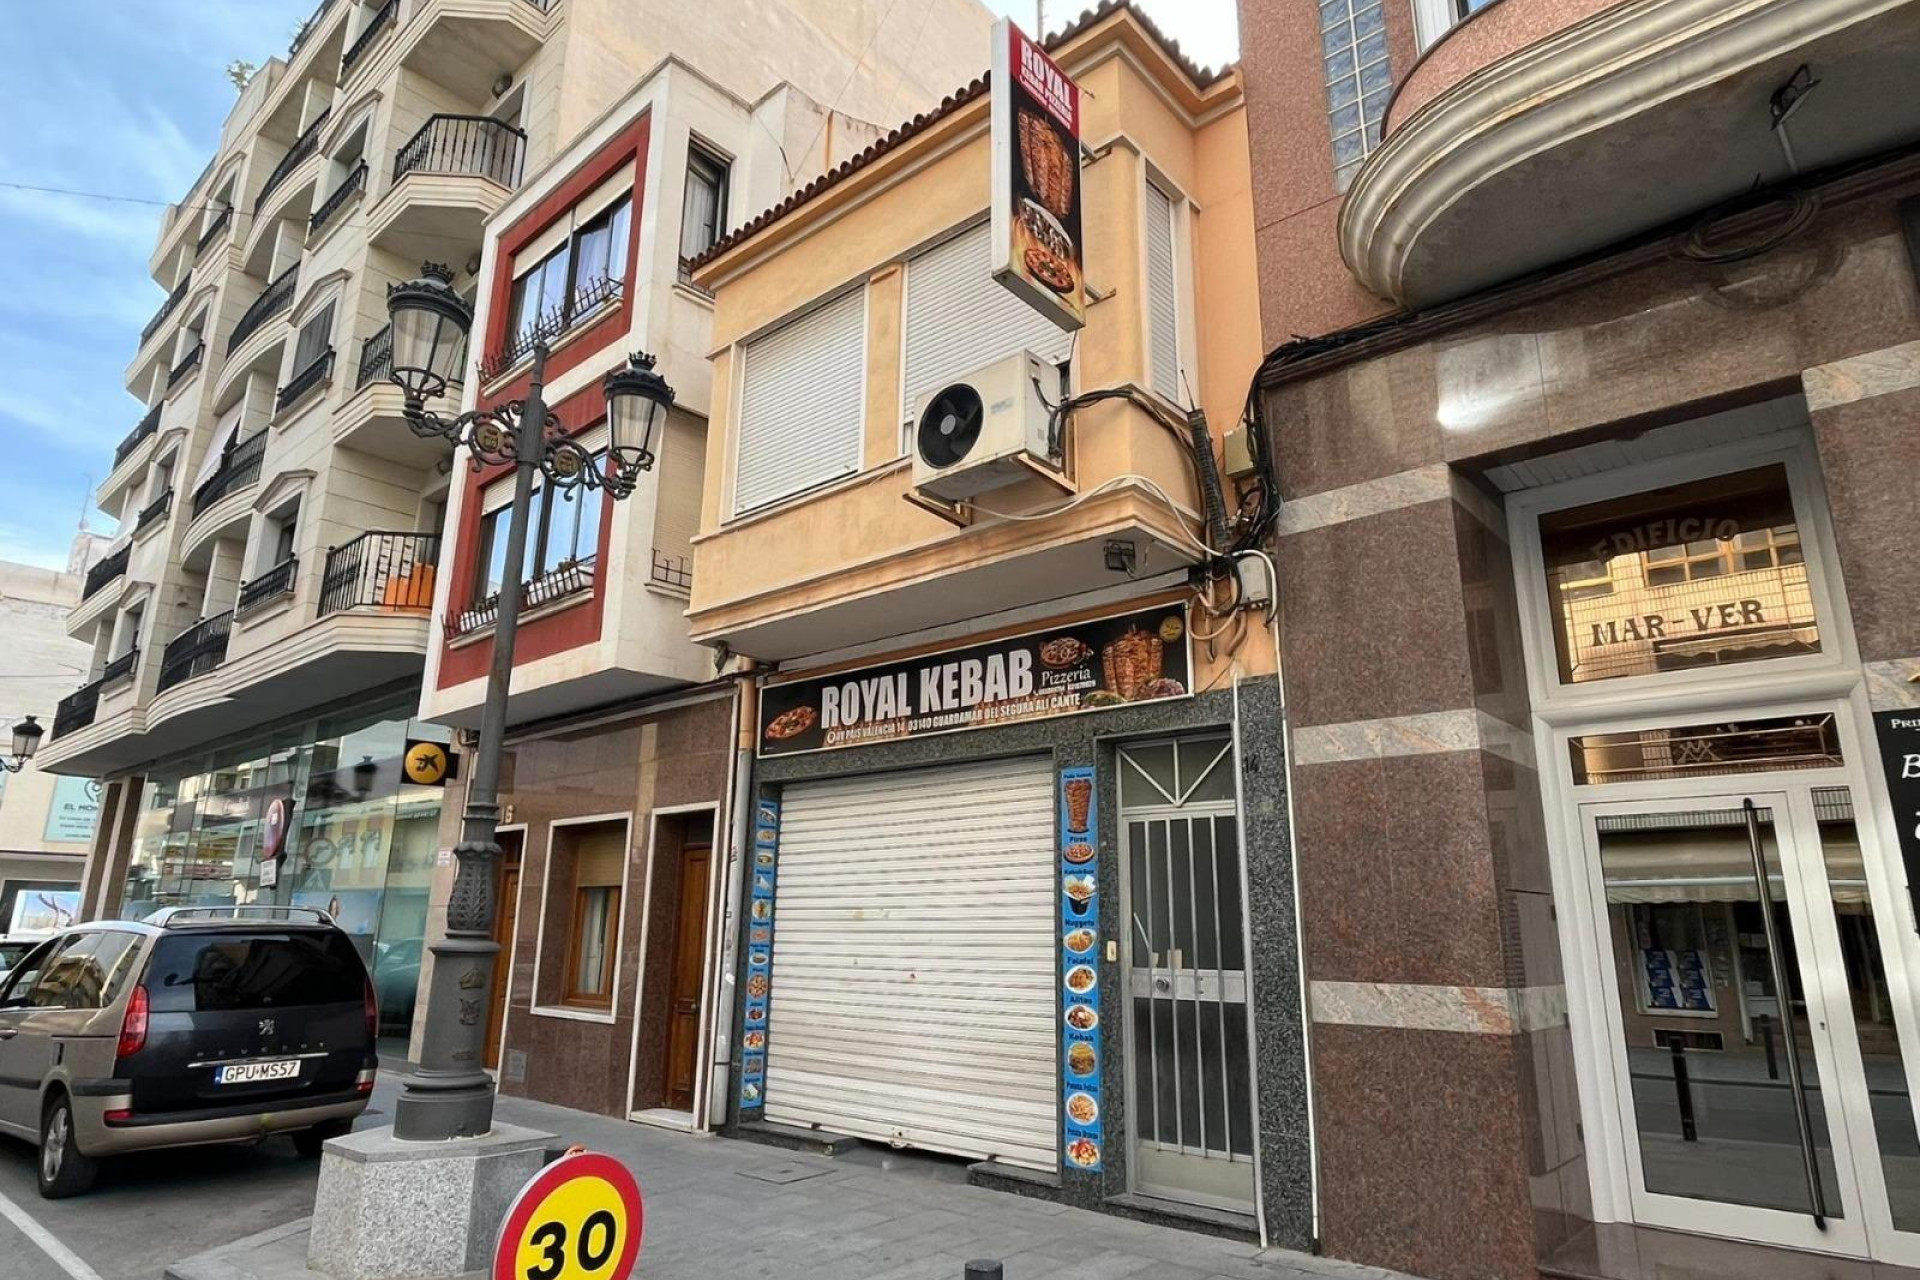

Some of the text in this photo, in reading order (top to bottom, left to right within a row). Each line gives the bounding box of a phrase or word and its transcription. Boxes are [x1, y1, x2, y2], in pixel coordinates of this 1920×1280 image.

[1021, 38, 1072, 112] ROYAL
[1591, 517, 1740, 564] EDIFICIO
[1591, 599, 1766, 647] MAR-VER
[820, 649, 1033, 729] ROYAL KEBAB
[1041, 664, 1091, 687] Pizzeria
[907, 717, 932, 731] 03140
[932, 709, 983, 728] GUARDAMAR
[983, 706, 999, 719] DEL
[1000, 701, 1034, 716] SEGURA
[1065, 919, 1095, 928] Nuggets
[1067, 956, 1094, 965] Falafel
[1069, 1033, 1094, 1042] Kebab
[526, 1209, 617, 1280] 30
